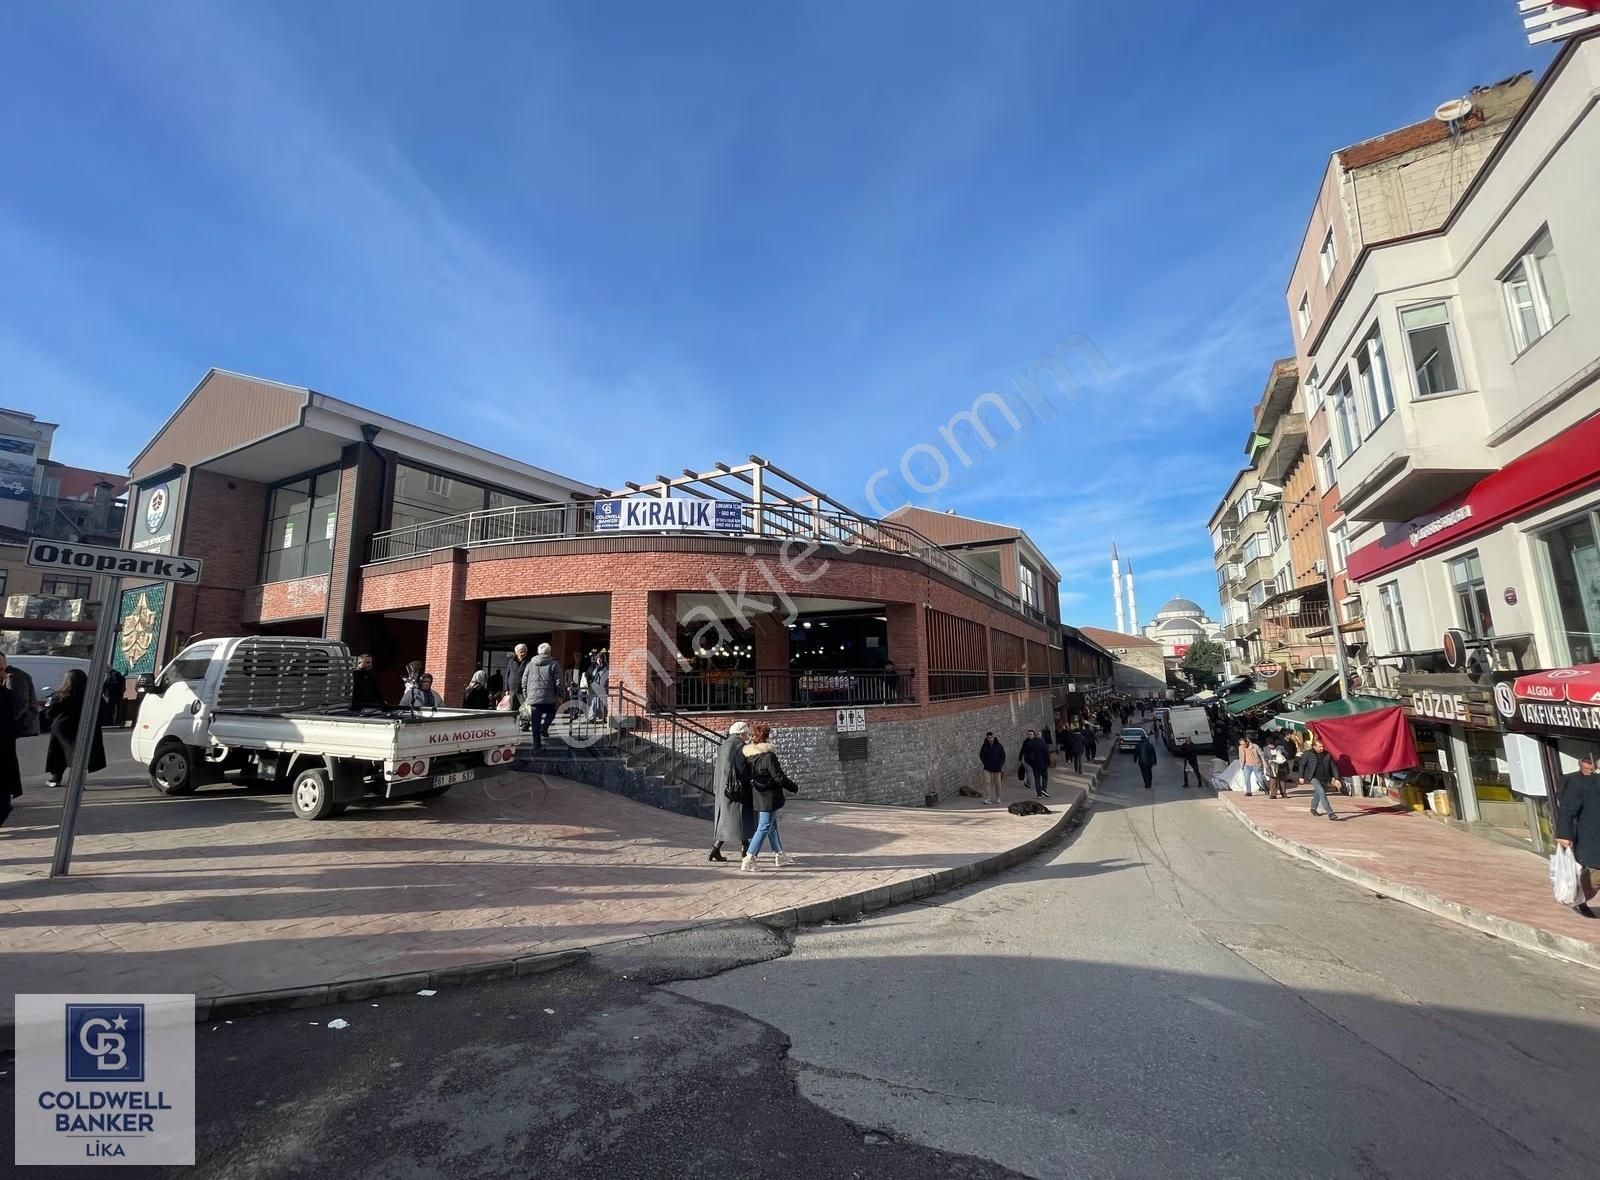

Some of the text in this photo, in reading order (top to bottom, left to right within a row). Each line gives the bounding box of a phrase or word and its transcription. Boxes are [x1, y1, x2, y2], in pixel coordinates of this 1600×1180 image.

[34, 544, 174, 577] Otopark
[1527, 686, 1553, 697] ALGIDA
[1412, 690, 1467, 721] GÖZDE
[1519, 701, 1582, 728] VAKFIKEBİR
[429, 728, 496, 744] KIA MOTORS
